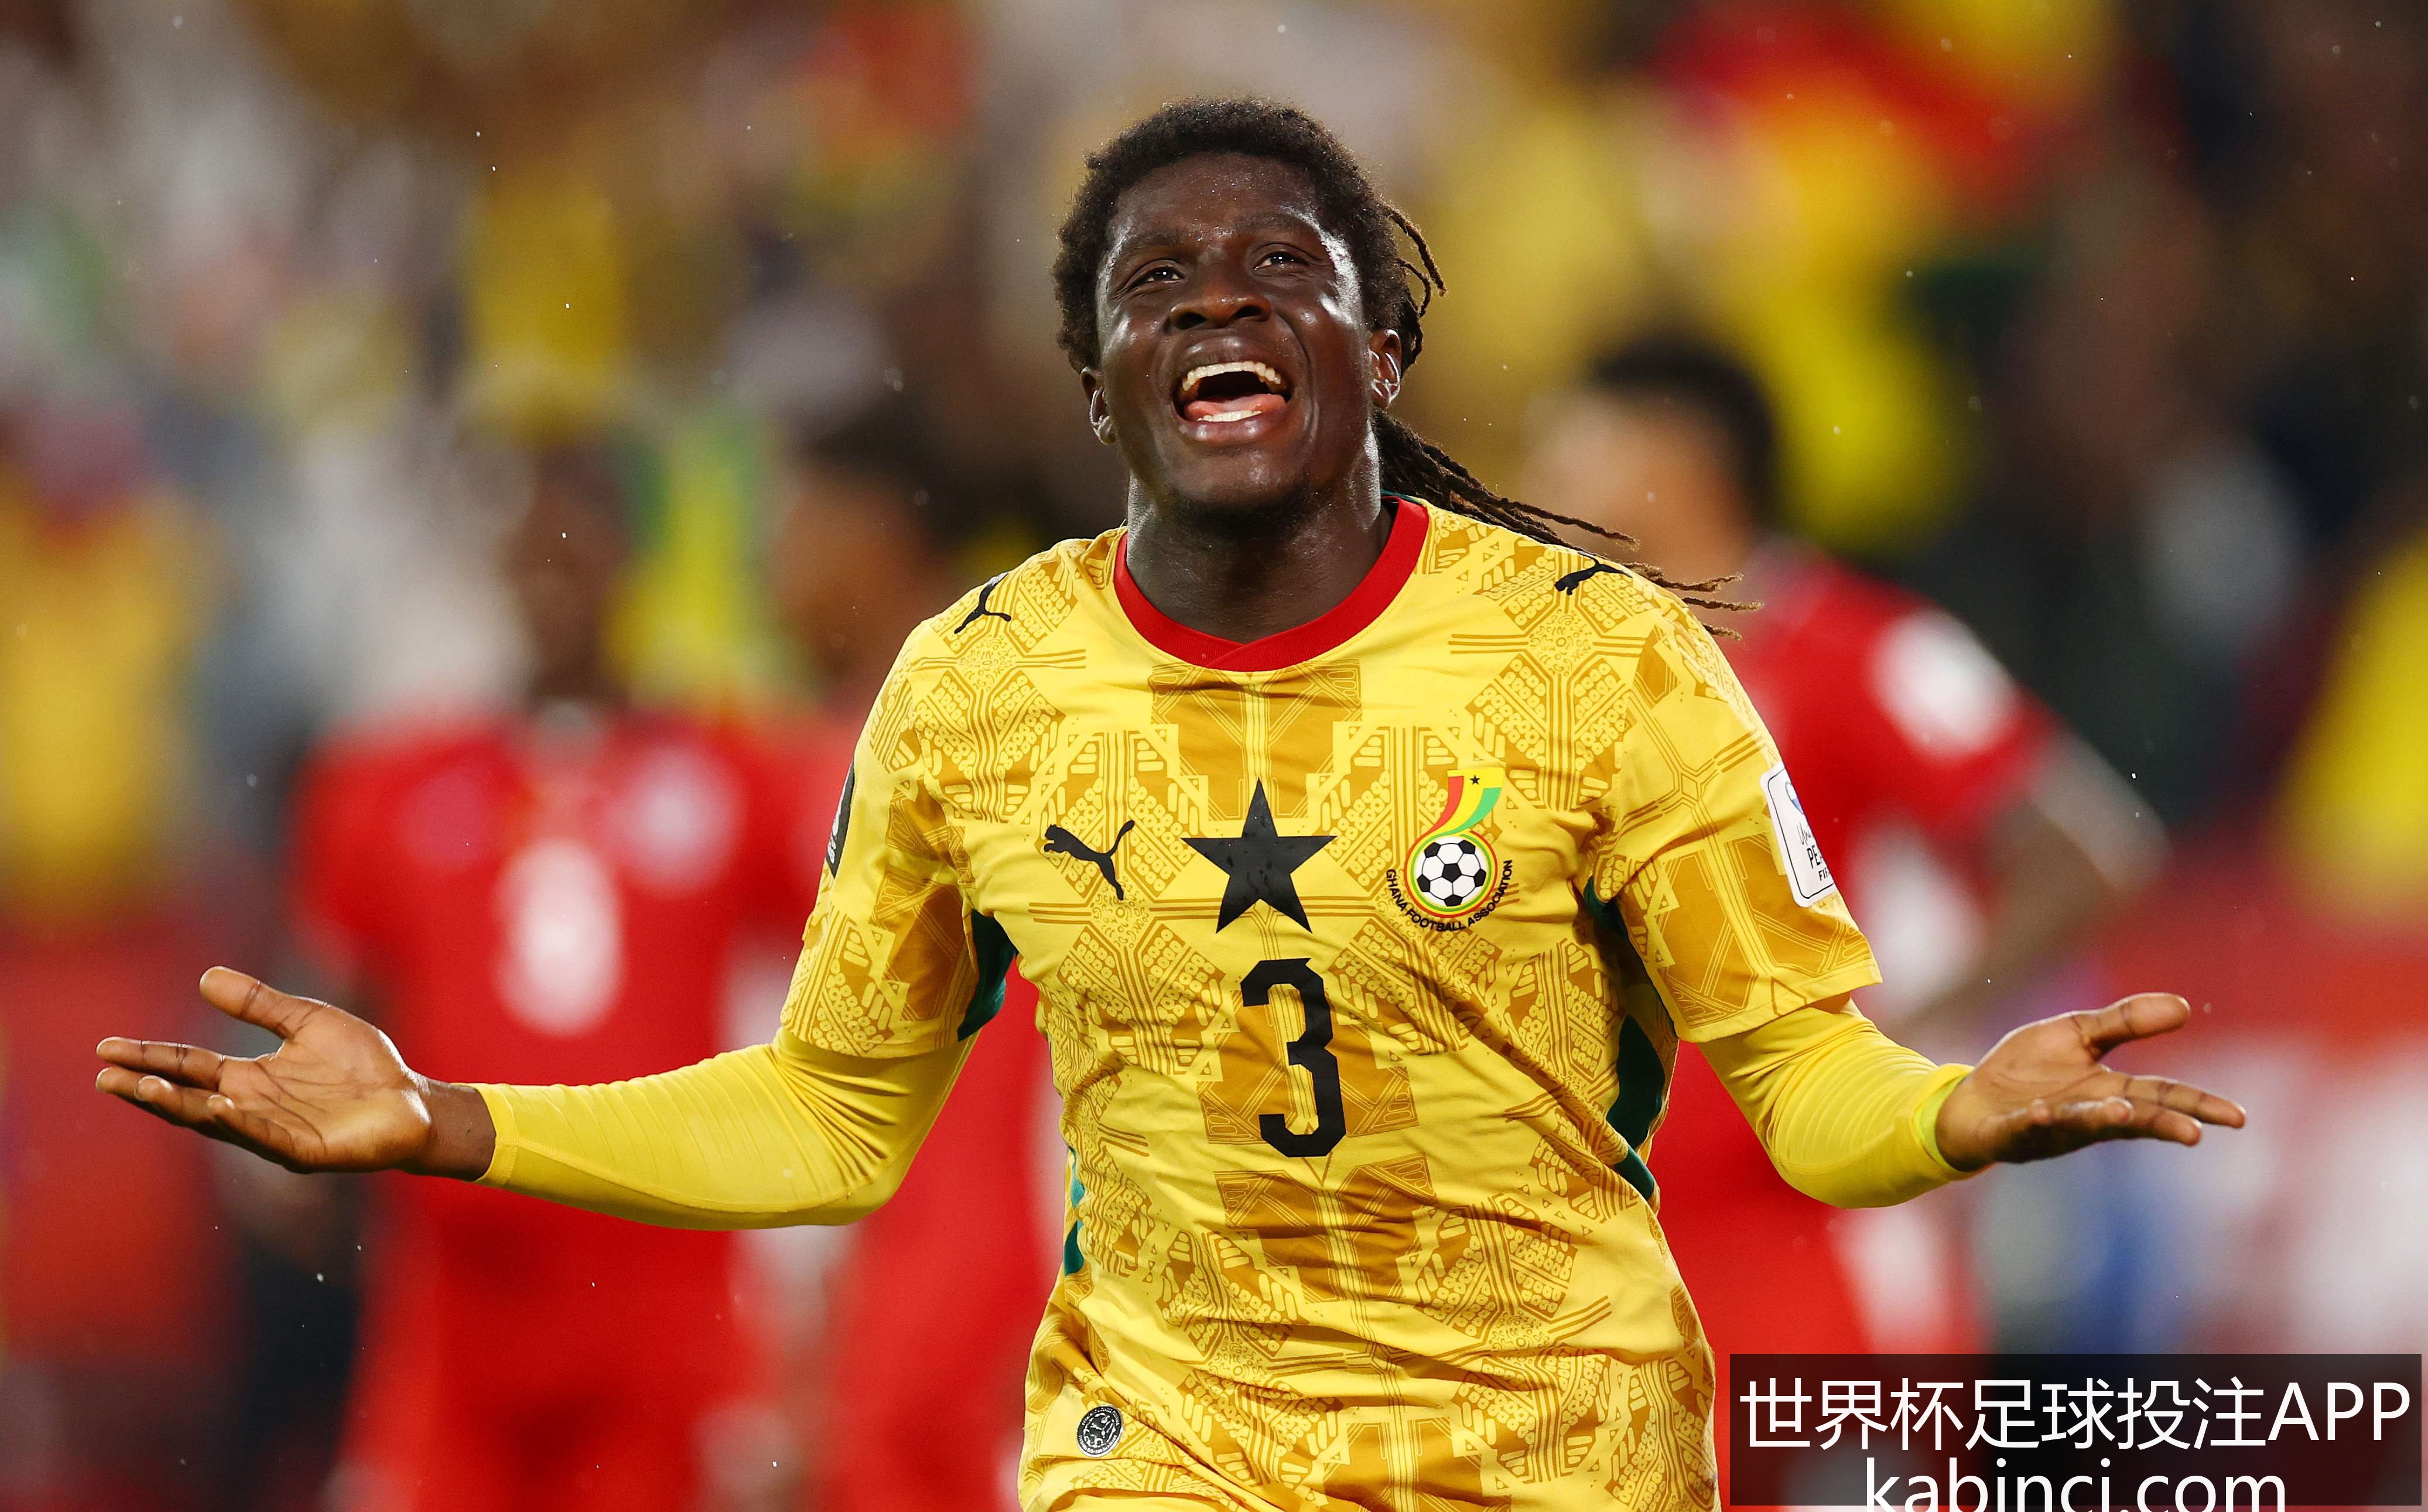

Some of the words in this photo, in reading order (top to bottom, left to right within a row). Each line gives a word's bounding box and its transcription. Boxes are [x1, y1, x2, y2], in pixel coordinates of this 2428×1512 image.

[1807, 844, 1822, 869] PE
[1386, 869, 1408, 911] GHANA
[1405, 909, 1466, 932] FOOTBALL
[1468, 860, 1513, 927] ASSOCIATION
[1240, 957, 1346, 1158] 3
